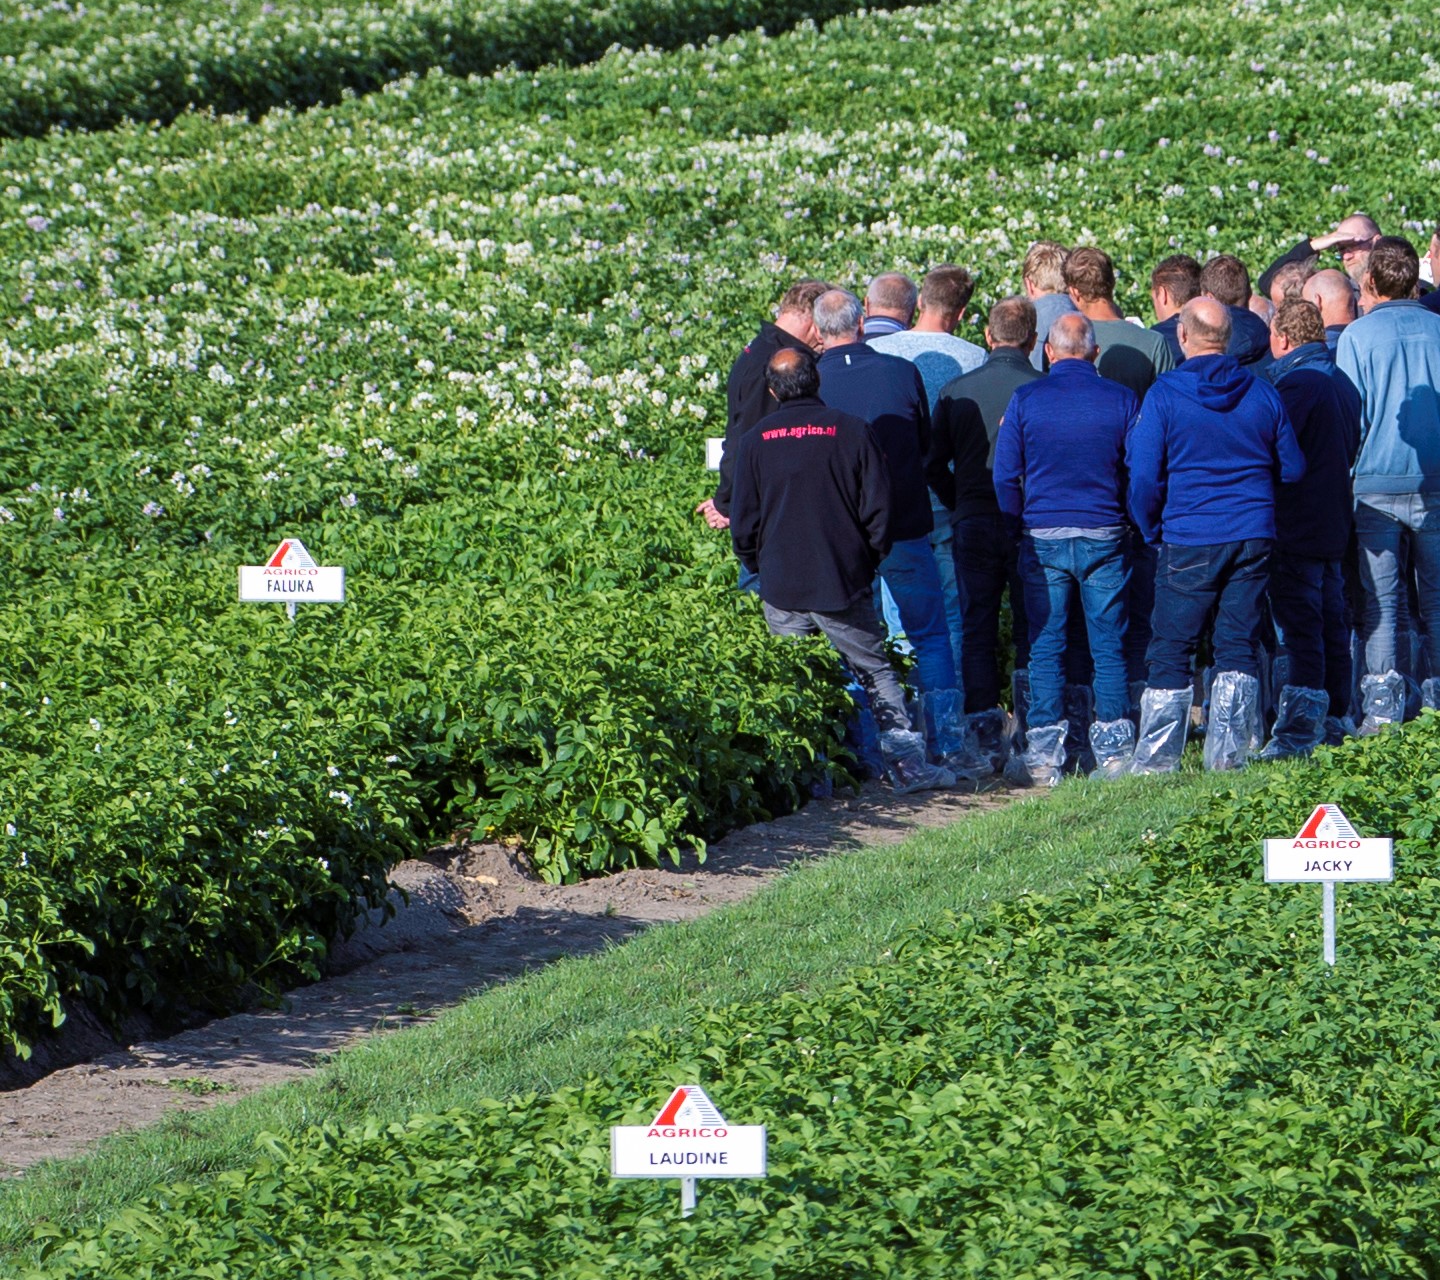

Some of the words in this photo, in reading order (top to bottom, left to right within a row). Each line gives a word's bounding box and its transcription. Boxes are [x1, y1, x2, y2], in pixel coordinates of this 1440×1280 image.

[761, 423, 836, 441] www.agrico.nl
[263, 568, 319, 576] AGRICO
[266, 579, 315, 593] FALUKA
[1292, 839, 1361, 849] AGRICO
[1303, 860, 1353, 872] JACKY
[647, 1127, 729, 1139] AGRICO
[651, 1151, 728, 1165] LAUDINE
